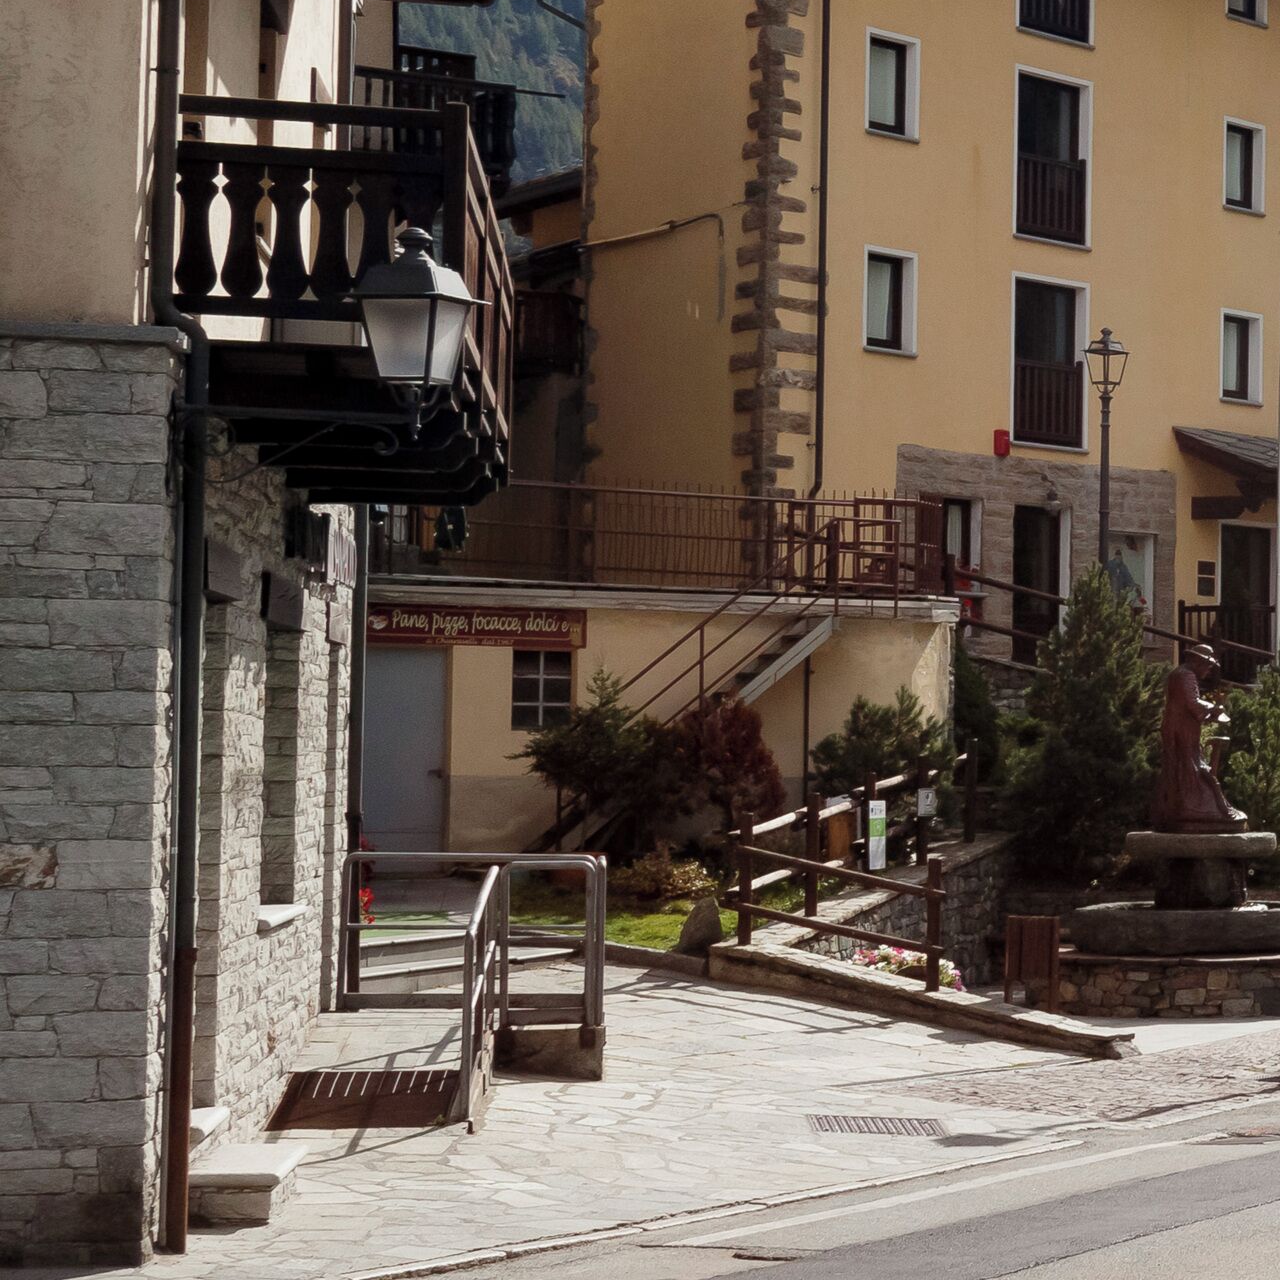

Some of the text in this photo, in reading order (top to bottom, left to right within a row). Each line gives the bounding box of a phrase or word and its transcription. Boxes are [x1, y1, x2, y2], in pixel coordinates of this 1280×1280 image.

[392, 609, 429, 631] Pane,
[432, 612, 469, 636] pizze,
[472, 610, 522, 634] focacce,
[525, 611, 559, 632] dolci
